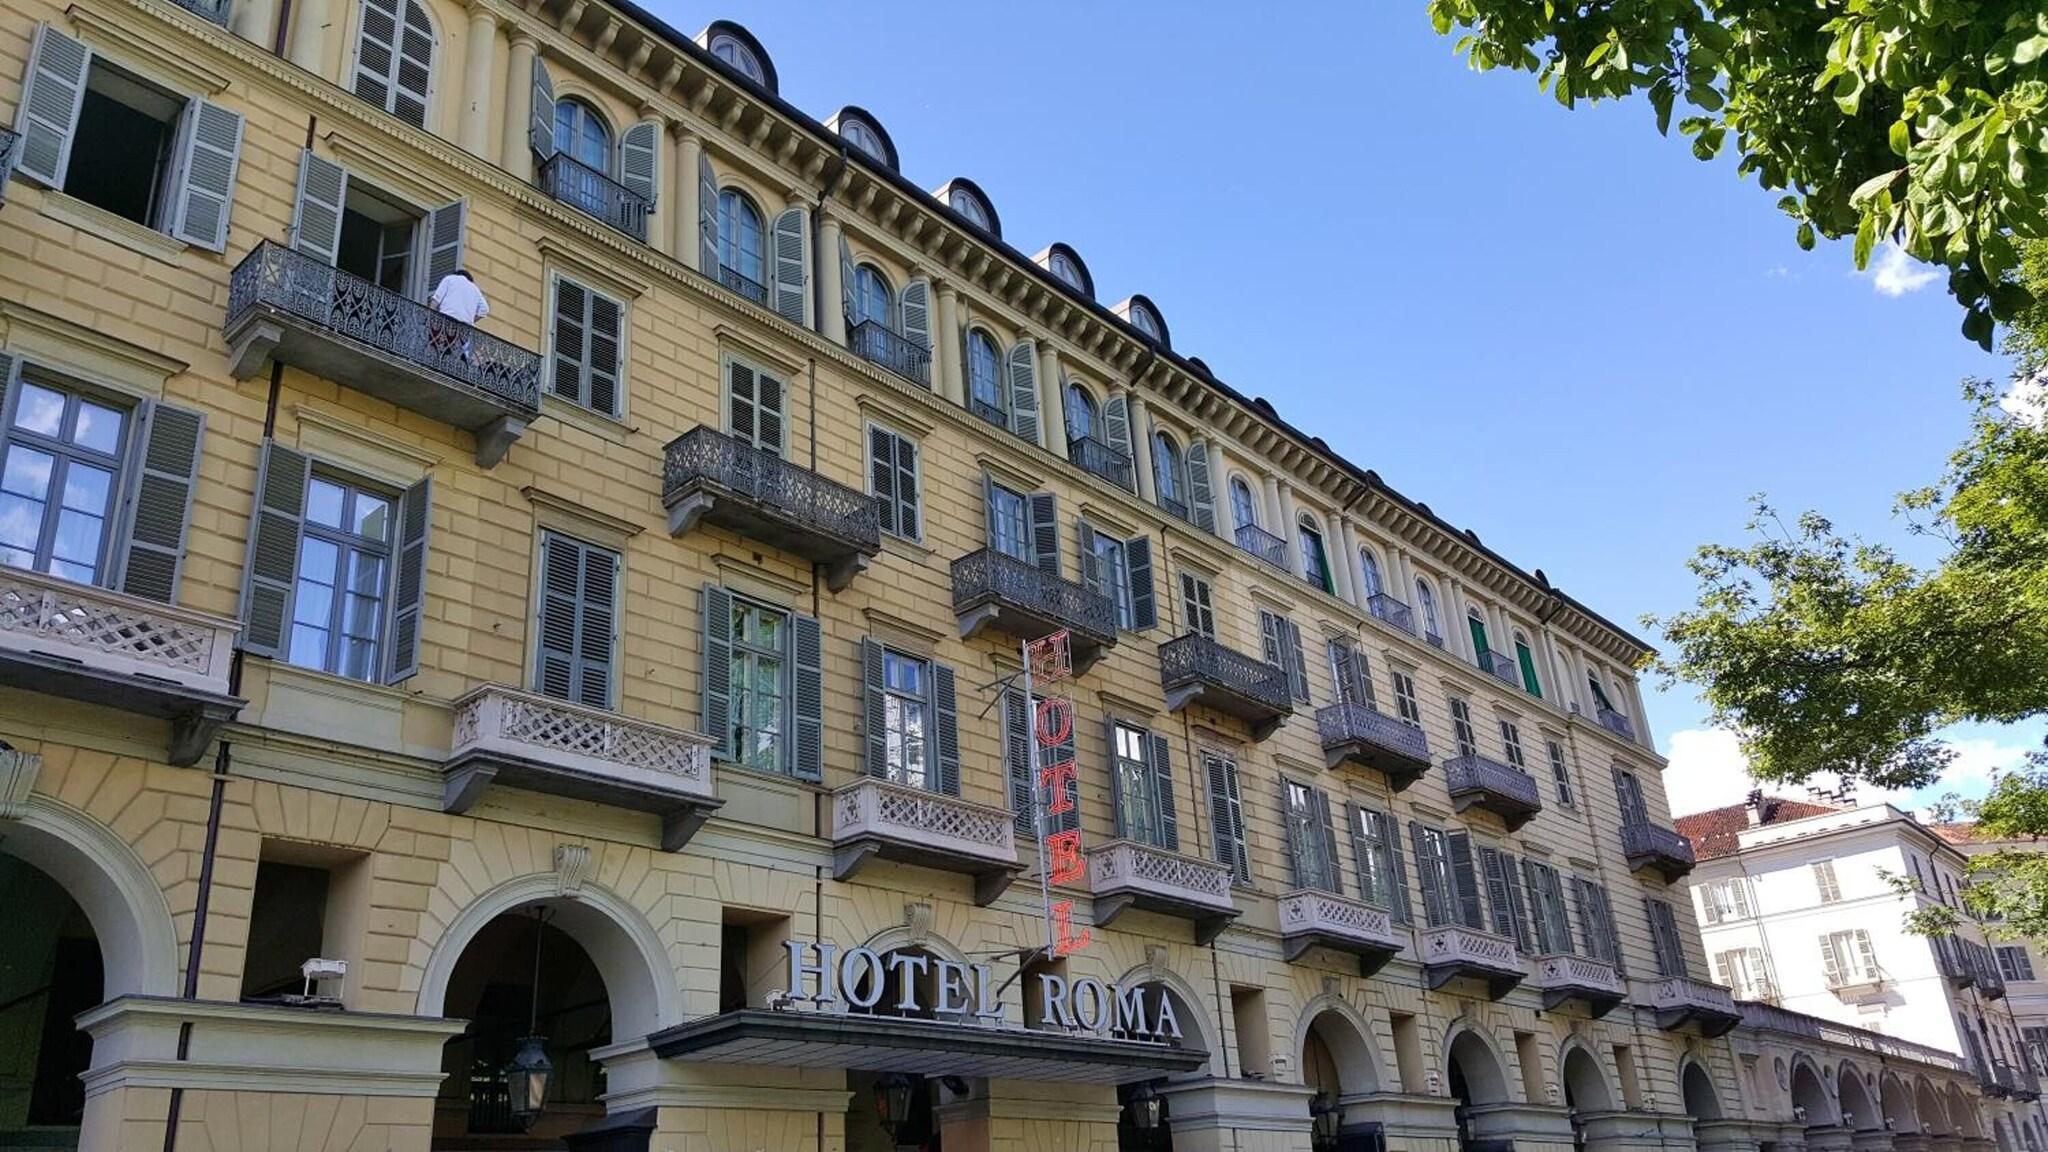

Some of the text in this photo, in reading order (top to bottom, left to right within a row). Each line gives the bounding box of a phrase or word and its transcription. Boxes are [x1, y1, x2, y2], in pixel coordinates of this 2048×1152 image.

[1028, 630, 1090, 955] HOTEL
[785, 940, 1183, 1038] HOTEL ROMA
